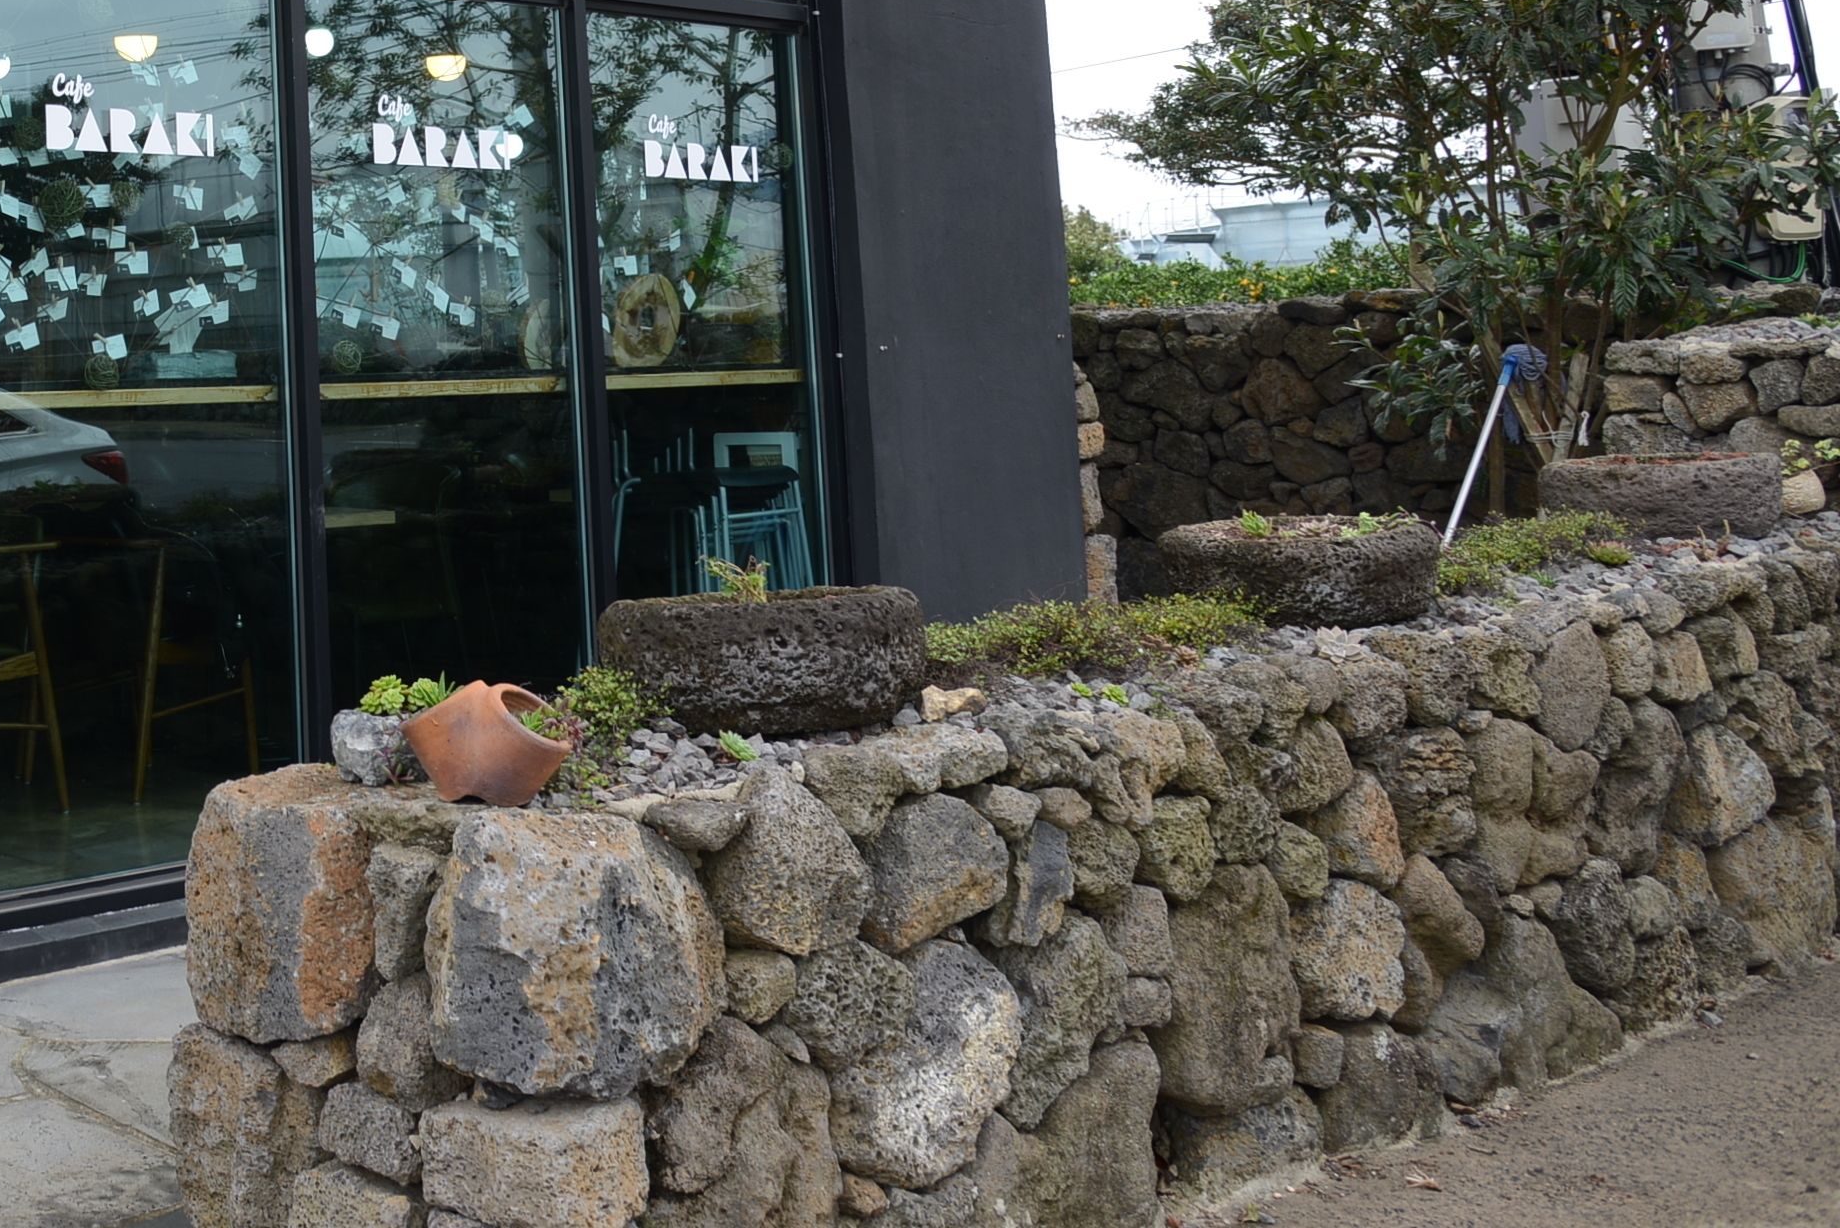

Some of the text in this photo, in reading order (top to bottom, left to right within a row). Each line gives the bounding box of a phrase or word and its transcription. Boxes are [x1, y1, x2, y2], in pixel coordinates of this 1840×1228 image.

[52, 73, 94, 104] Cafe
[378, 94, 412, 122] Cafe
[648, 114, 677, 139] Cafe
[45, 104, 215, 157] BARAKI
[372, 122, 512, 171] BARAKI
[644, 139, 759, 183] BARAKI
